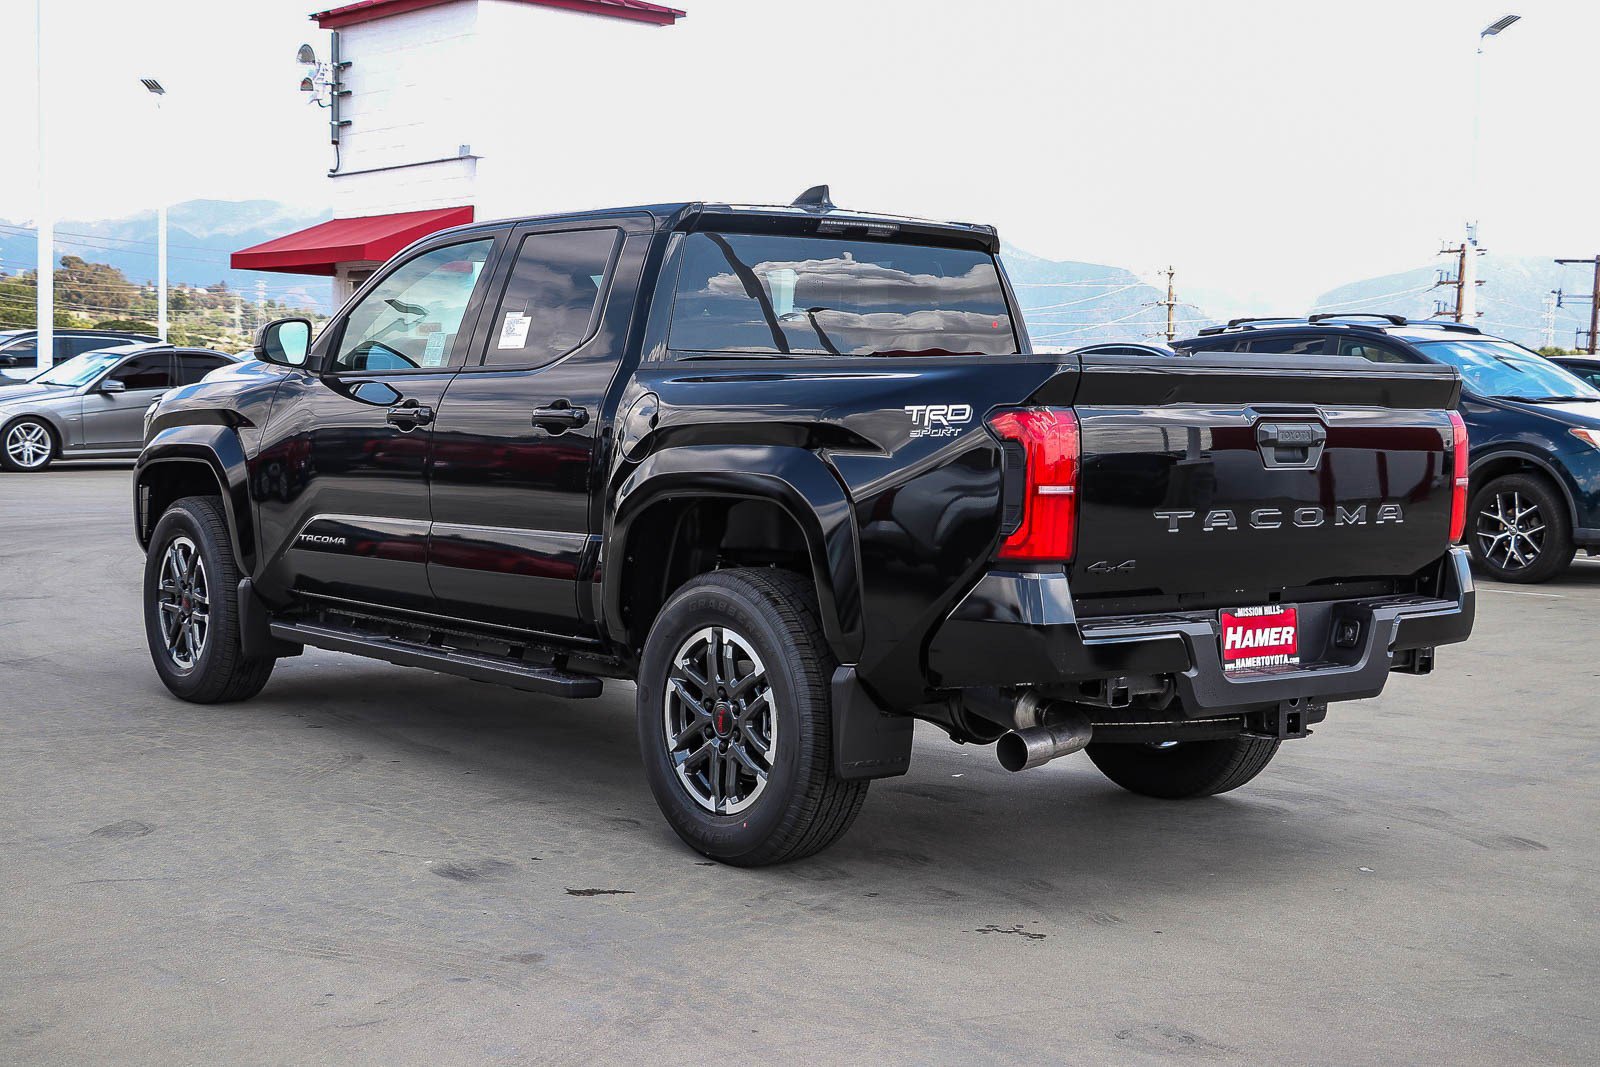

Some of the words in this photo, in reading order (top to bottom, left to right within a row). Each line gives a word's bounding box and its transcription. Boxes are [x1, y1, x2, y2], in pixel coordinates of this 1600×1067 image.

[904, 404, 973, 429] TRD
[909, 427, 962, 438] SPORT
[1280, 431, 1312, 440] TOYOTA
[1153, 504, 1404, 532] TACOMA
[299, 534, 346, 544] TACOMA
[1224, 626, 1295, 650] HAMER
